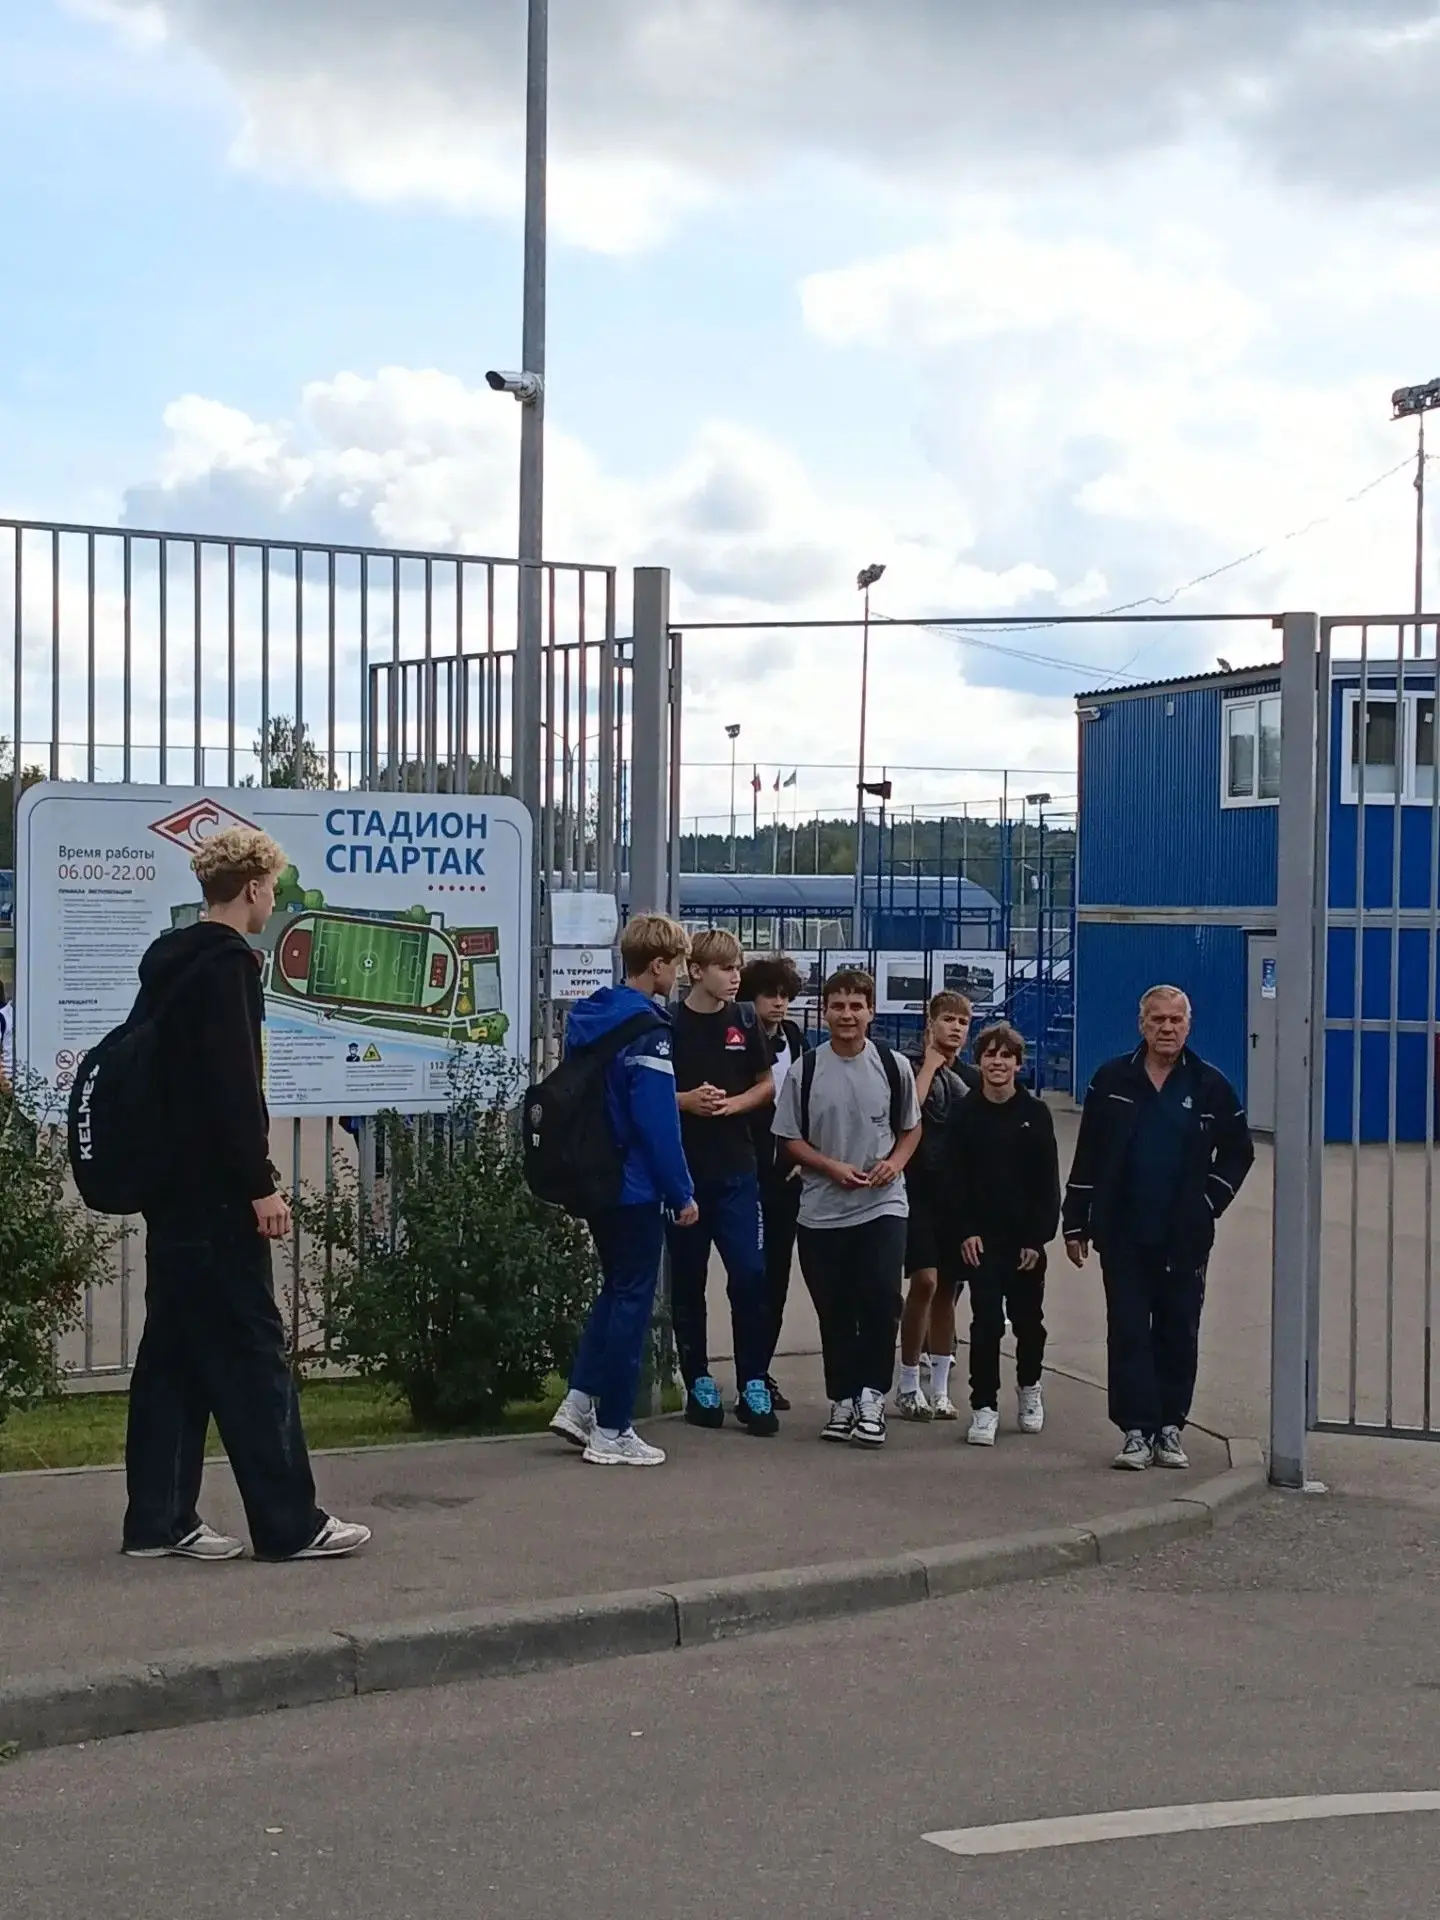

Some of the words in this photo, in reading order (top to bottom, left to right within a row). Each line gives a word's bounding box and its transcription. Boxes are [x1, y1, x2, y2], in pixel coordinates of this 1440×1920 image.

[325, 808, 487, 844] СТАДИОН
[58, 845, 102, 861] Время
[105, 846, 155, 861] работы
[325, 844, 486, 876] СПАРТАК
[58, 864, 156, 881] 06.00-22.00
[552, 968, 565, 976] НА
[559, 989, 592, 997] ЗАПРЕ
[430, 1061, 445, 1070] 112
[78, 1080, 94, 1160] KELME
